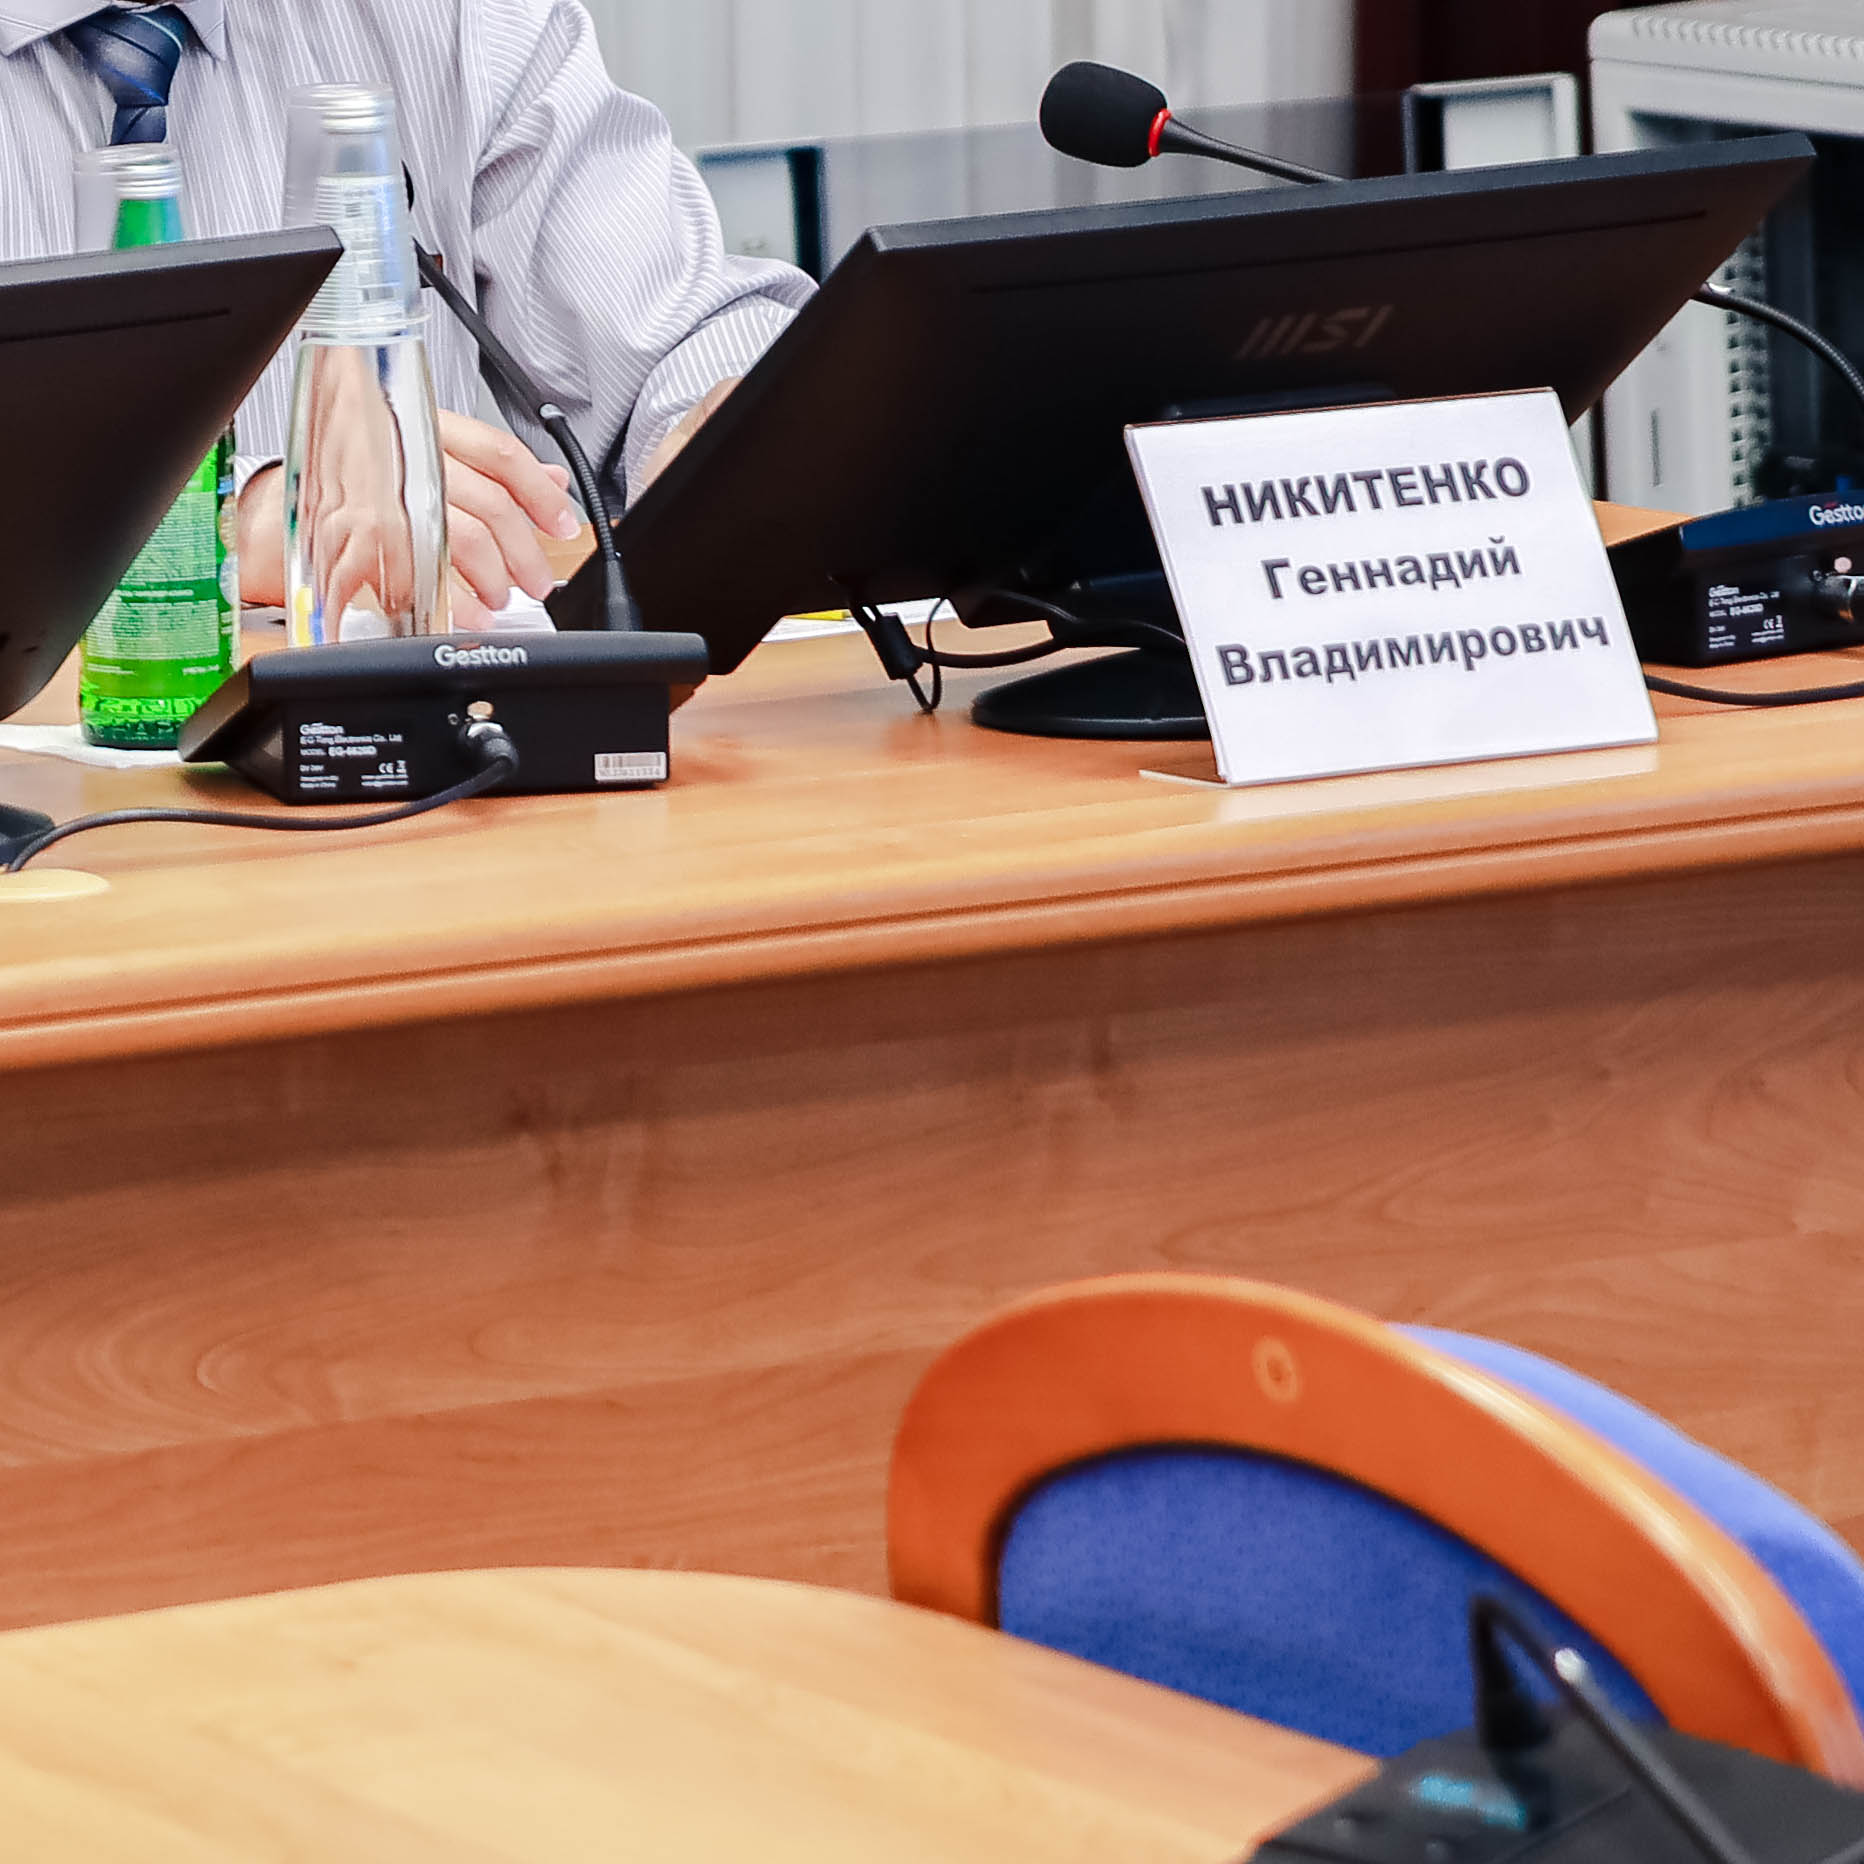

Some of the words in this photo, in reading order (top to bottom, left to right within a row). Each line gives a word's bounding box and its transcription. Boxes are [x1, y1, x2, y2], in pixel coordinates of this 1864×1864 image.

[1233, 304, 1394, 360] MSI
[1200, 456, 1531, 527] НИКИТЕНКО
[1809, 503, 1864, 526] Gestto
[1261, 536, 1522, 599] Геннадий
[434, 644, 528, 667] Gestton
[1216, 615, 1611, 686] Владимирович
